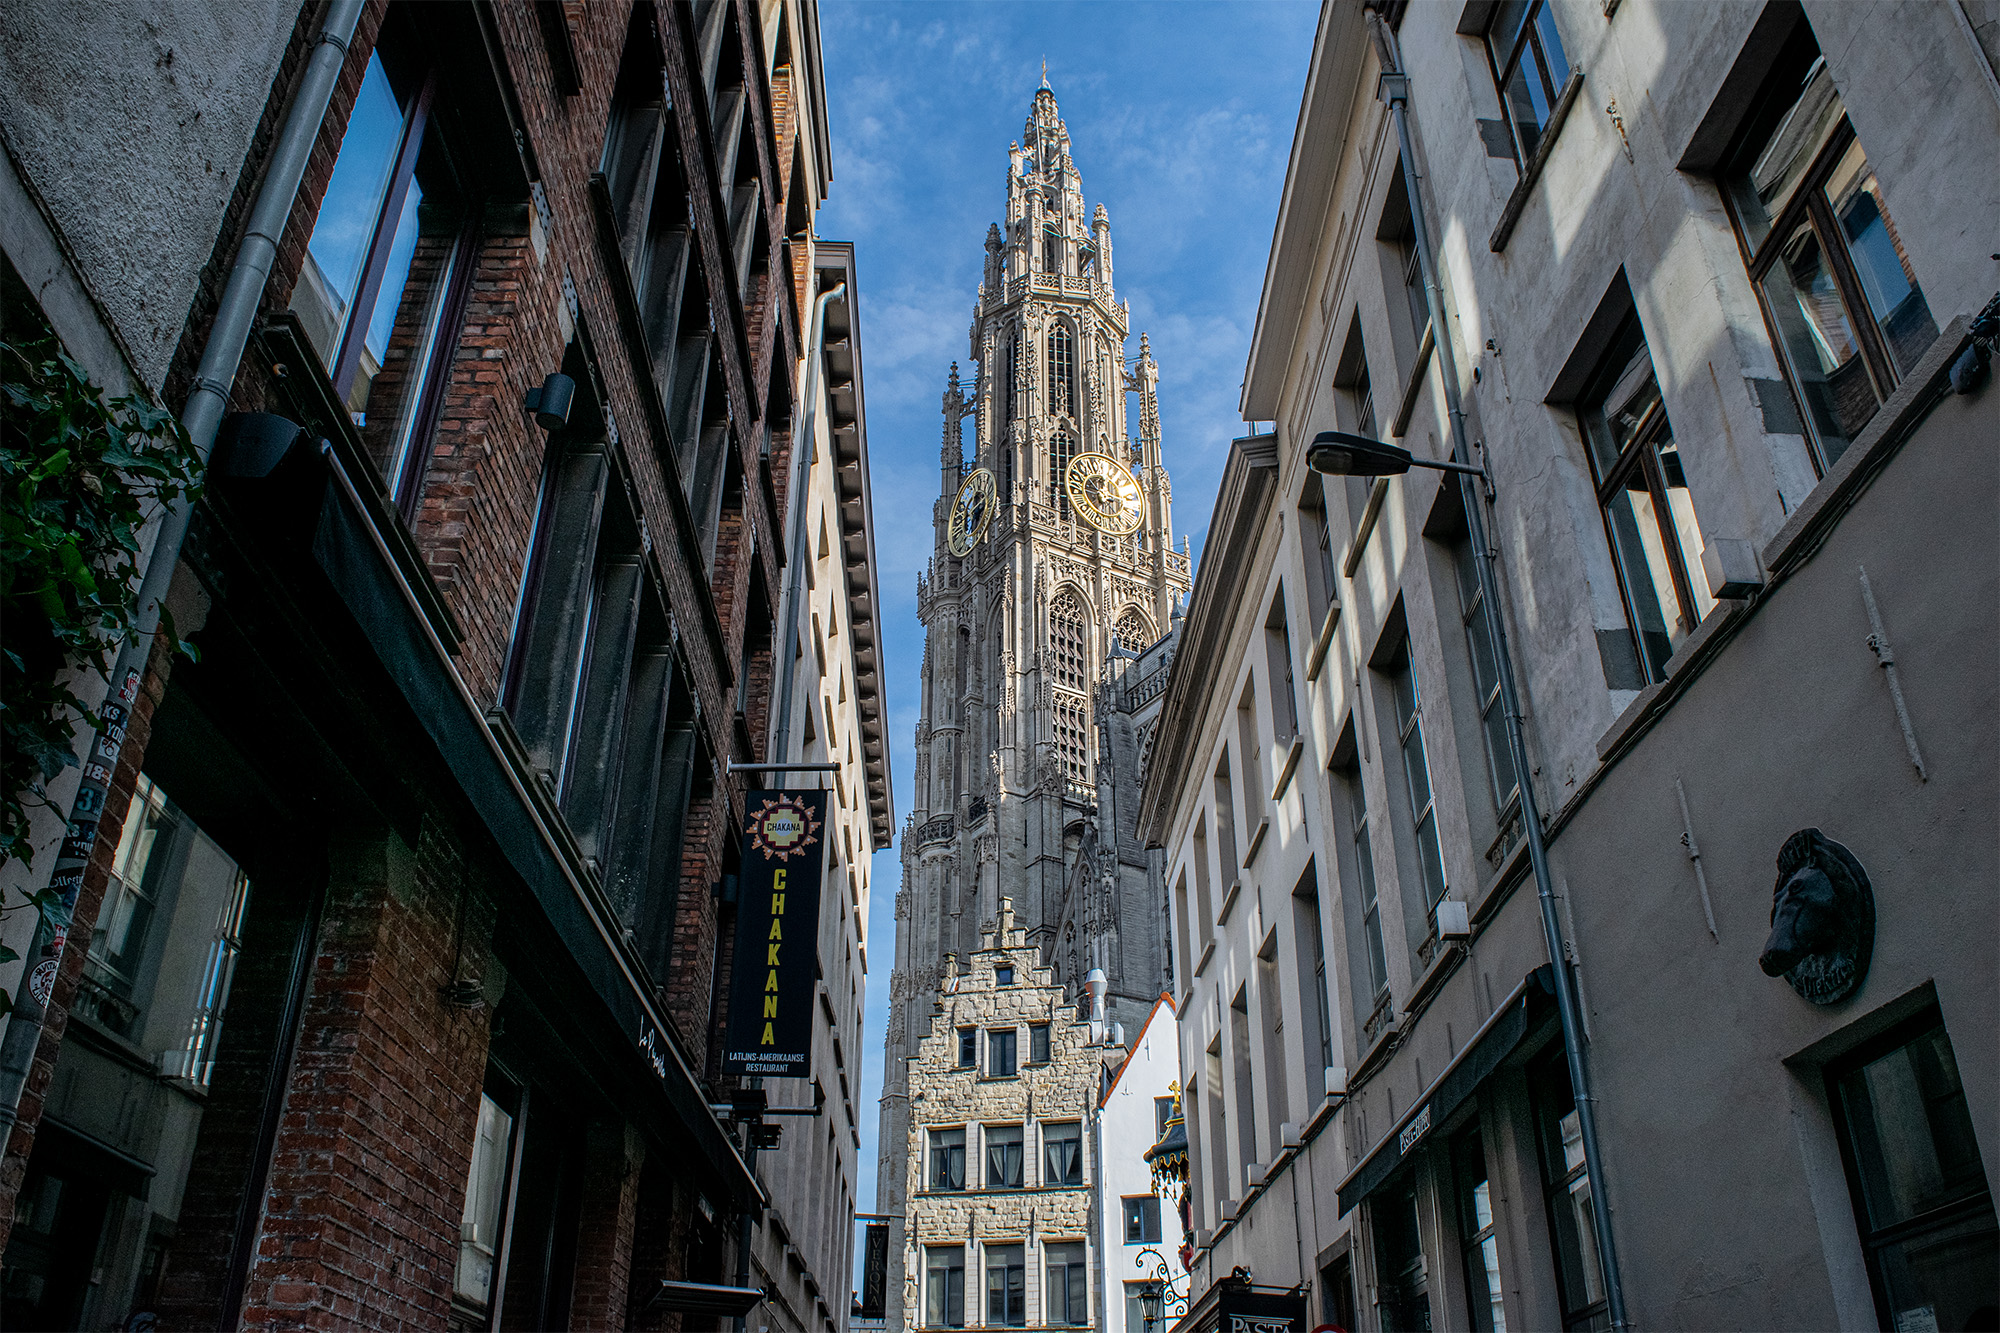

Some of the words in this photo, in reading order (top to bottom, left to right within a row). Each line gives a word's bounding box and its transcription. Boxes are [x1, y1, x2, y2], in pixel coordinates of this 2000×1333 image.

[767, 822, 800, 833] CHAKANA
[761, 868, 787, 1045] CHAKANA
[729, 1052, 805, 1063] LATIJNS-AMERIKAANSE
[745, 1062, 789, 1073] RESTAURANT
[869, 1237, 882, 1306] VERONA
